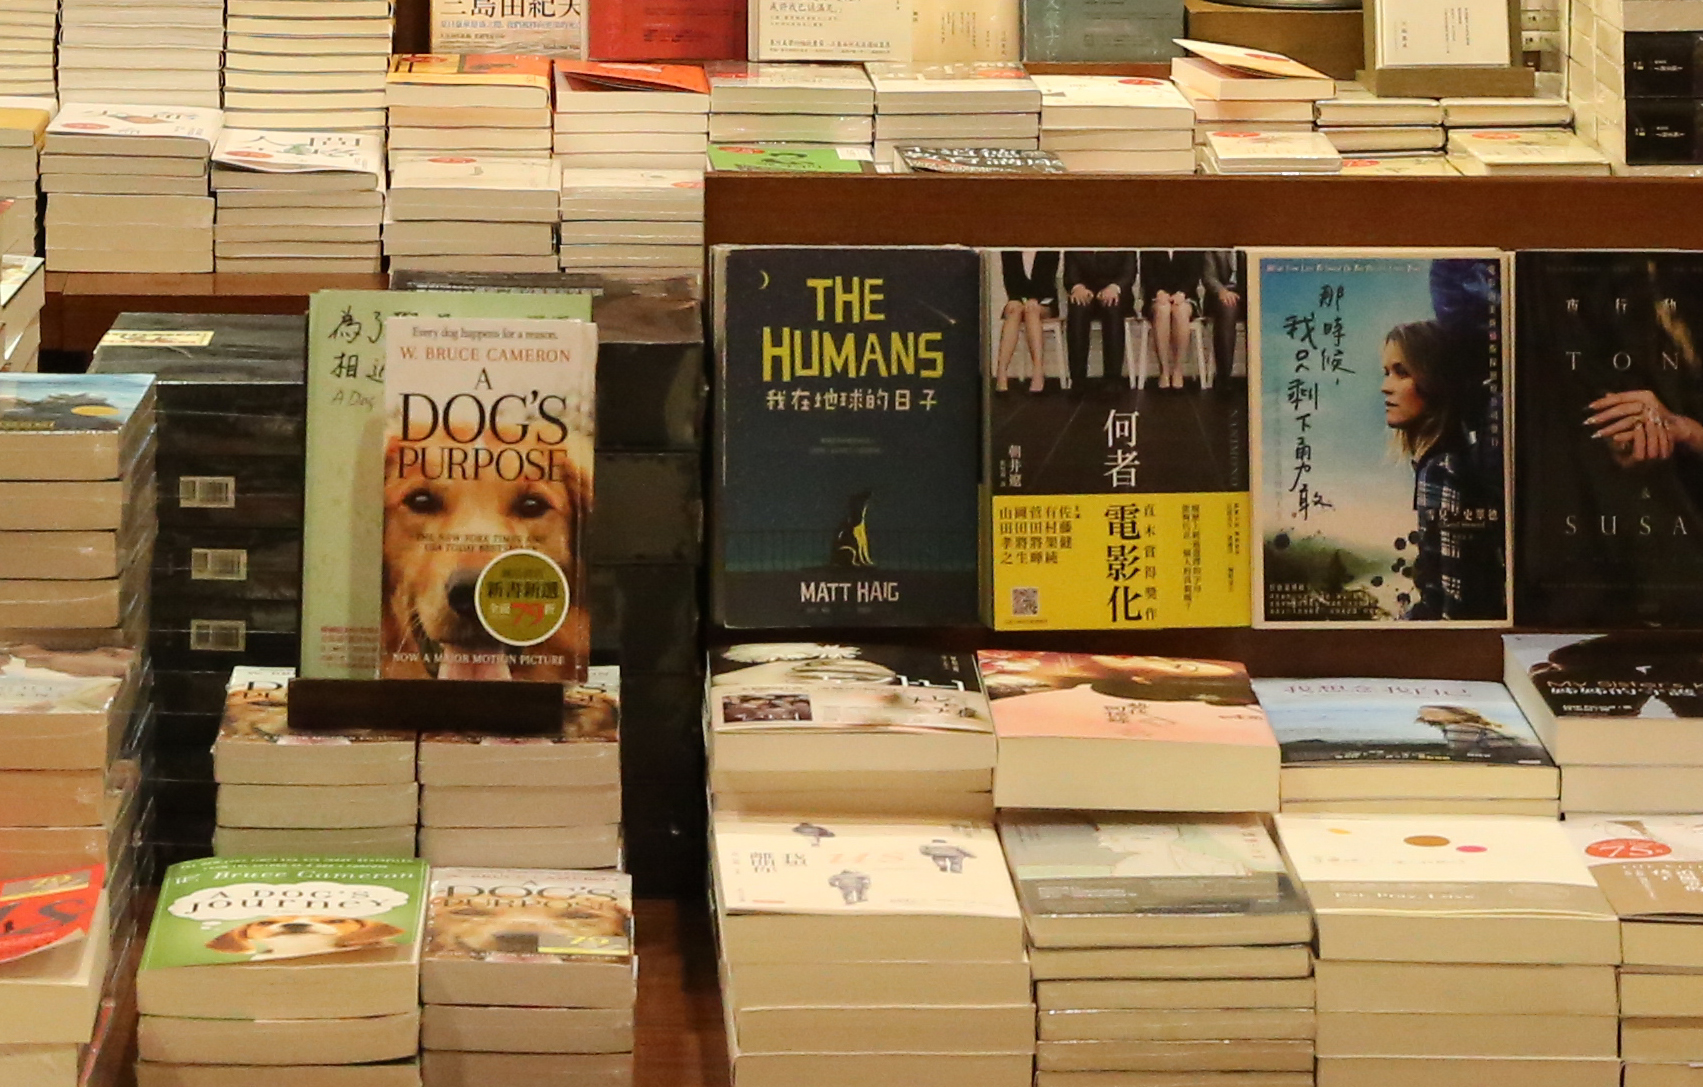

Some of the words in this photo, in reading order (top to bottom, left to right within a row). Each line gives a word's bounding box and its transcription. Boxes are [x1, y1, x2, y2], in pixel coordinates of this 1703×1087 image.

[806, 276, 886, 324] THE
[412, 326, 438, 340] Every
[441, 327, 458, 341] dog
[461, 327, 500, 341] happens
[502, 327, 515, 338] for
[400, 346, 418, 360] W.
[426, 347, 480, 361] BRUCE
[487, 348, 571, 362] CAMERON
[762, 326, 945, 382] HUMANS
[475, 367, 493, 390] A
[766, 388, 938, 411] 我在地球的日子
[398, 389, 569, 446] DOG'S
[1103, 408, 1141, 488] 何者
[398, 446, 568, 482] PURPOSE
[1000, 505, 1014, 565] 山田孝之
[1059, 505, 1073, 549] 佐藤健
[1103, 502, 1143, 623] 電影化
[800, 581, 852, 602] MATT
[856, 580, 900, 602] HAIG
[392, 653, 420, 663] NOW
[472, 654, 517, 665] MOTION
[520, 655, 565, 666] PICTURE
[213, 869, 290, 880] Bruce
[297, 870, 415, 881] Cameron
[253, 889, 371, 899] DOG'S
